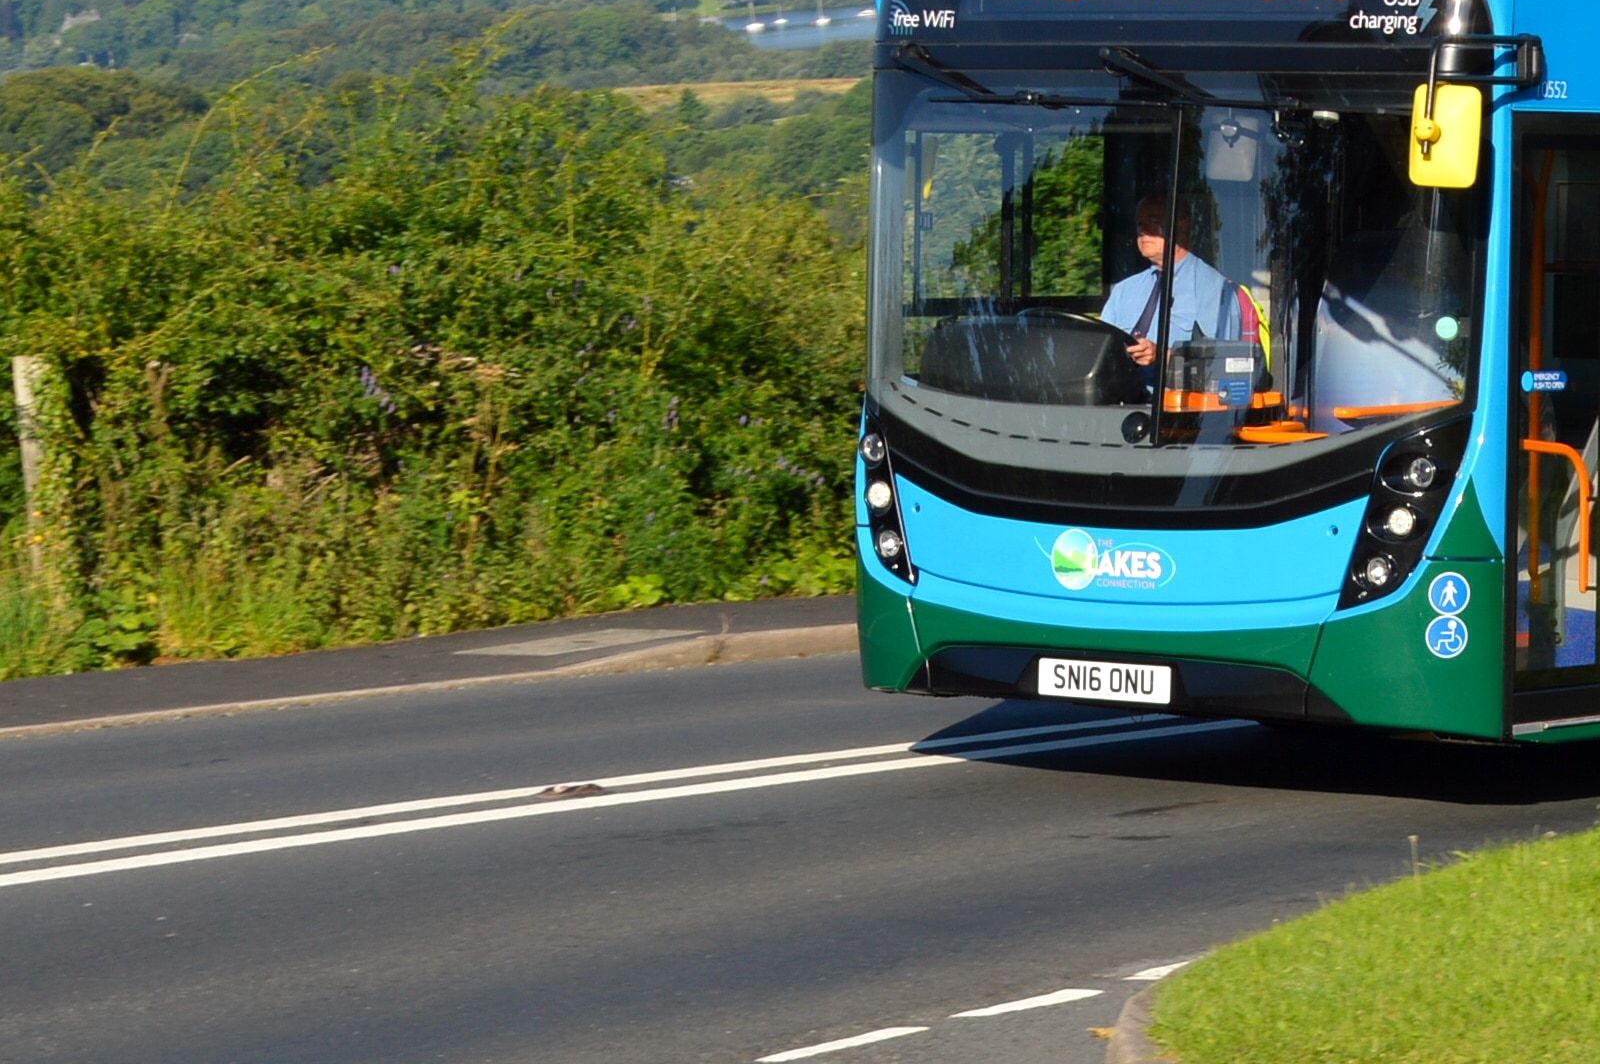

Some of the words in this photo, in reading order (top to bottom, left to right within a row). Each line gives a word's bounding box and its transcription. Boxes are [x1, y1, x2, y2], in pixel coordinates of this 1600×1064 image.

[893, 9, 920, 28] free
[922, 9, 956, 29] WiFi
[1349, 9, 1417, 35] charging
[1097, 538, 1114, 548] THE
[1086, 542, 1162, 579] LAKES
[1096, 577, 1156, 589] CONNECTION
[1053, 663, 1101, 690] SN16
[1109, 667, 1155, 695] ONU
